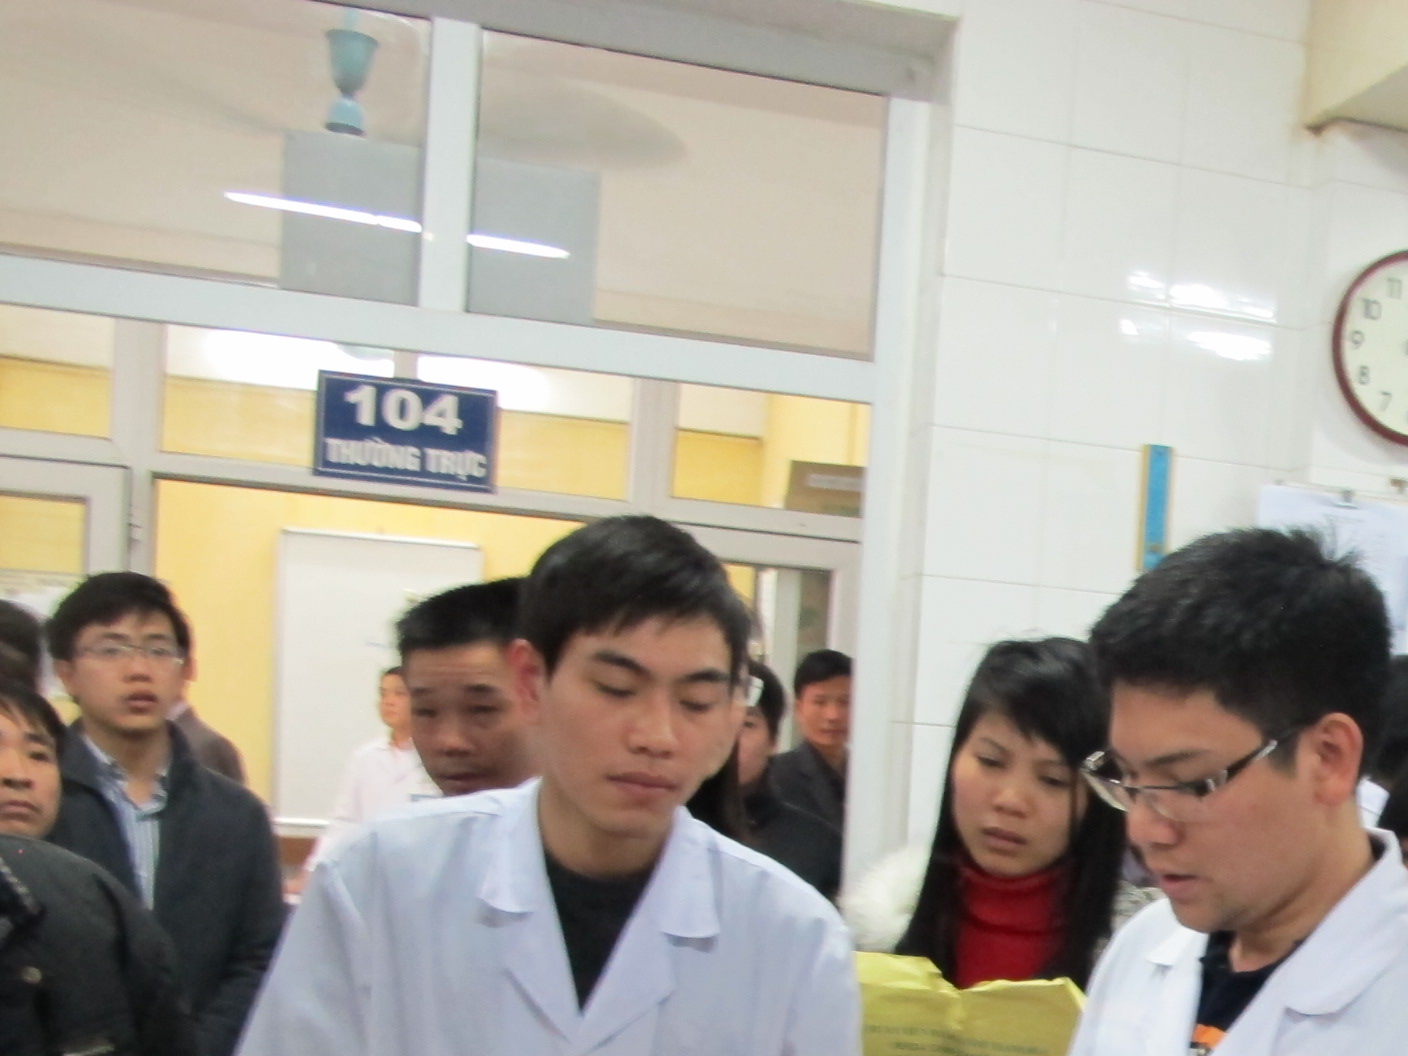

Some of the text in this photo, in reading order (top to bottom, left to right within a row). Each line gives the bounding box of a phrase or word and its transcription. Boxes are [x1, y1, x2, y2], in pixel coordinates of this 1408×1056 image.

[1387, 277, 1402, 299] 11
[1362, 298, 1383, 320] 10
[1350, 330, 1365, 349] 9
[1357, 365, 1371, 385] 8
[343, 384, 463, 436] 104
[1380, 390, 1393, 411] 7
